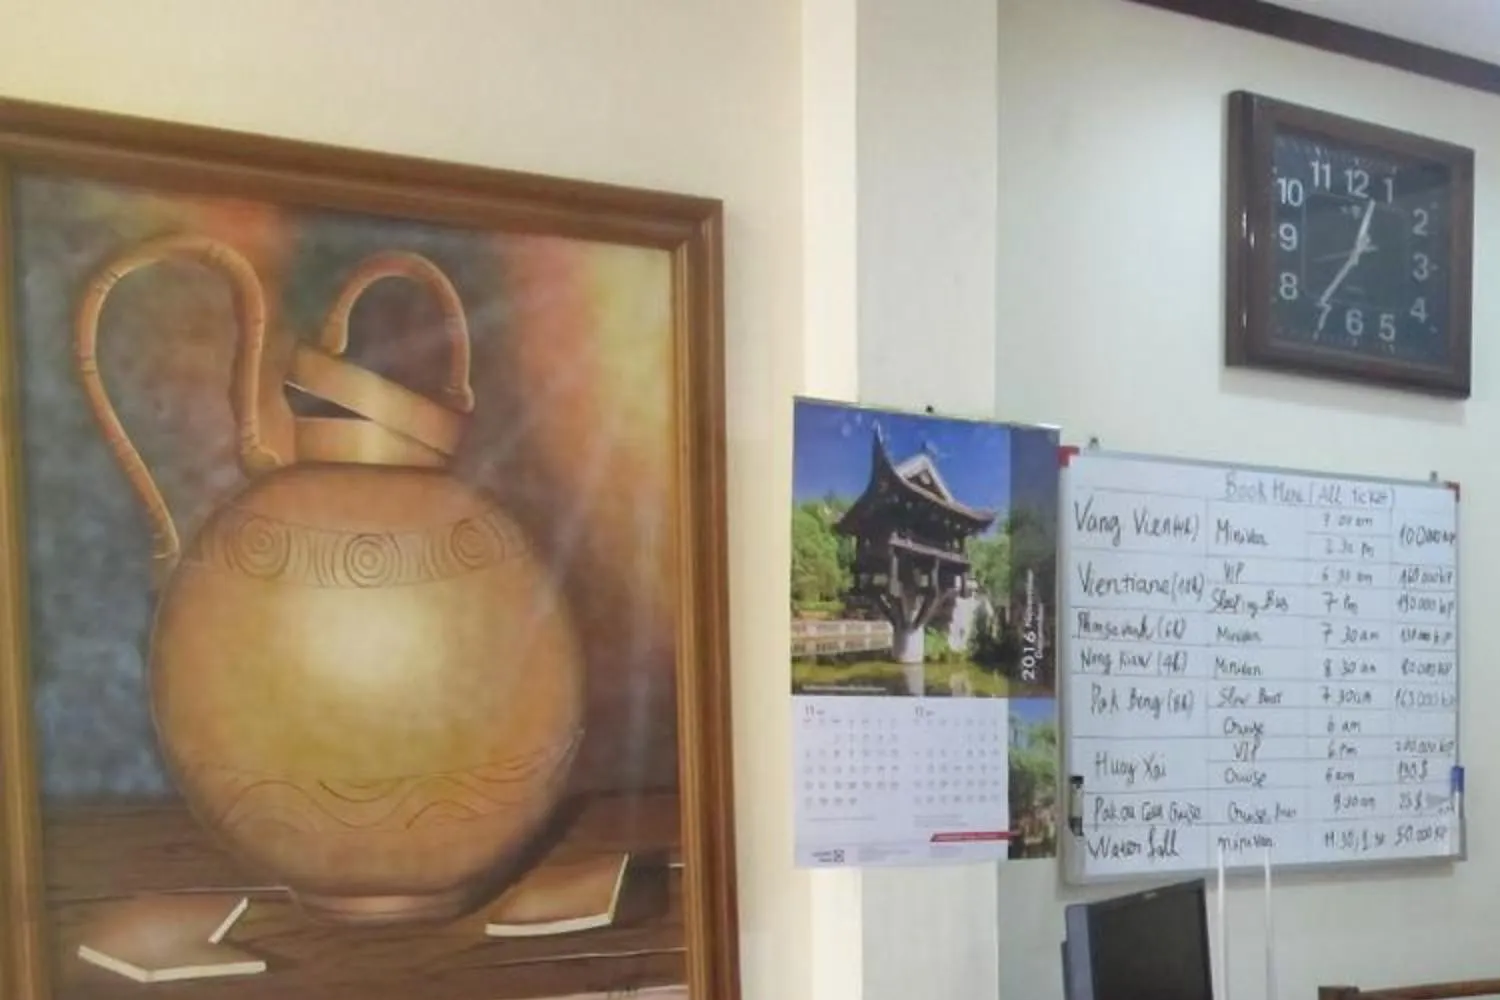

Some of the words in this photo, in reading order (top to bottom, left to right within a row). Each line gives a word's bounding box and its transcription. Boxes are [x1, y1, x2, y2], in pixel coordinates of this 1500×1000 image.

[1310, 160, 1331, 190] 11
[1344, 168, 1370, 199] 12
[1276, 176, 1303, 207] 10
[1383, 177, 1394, 204] 1
[1412, 208, 1428, 236] 2
[1279, 222, 1297, 251] 9
[1412, 253, 1429, 281] 3
[1279, 272, 1298, 300] 8
[1317, 300, 1332, 330] 7
[1345, 308, 1363, 336] 6
[1410, 297, 1428, 323] 4
[1379, 313, 1395, 341] 5
[1073, 496, 1122, 547] Vang
[1021, 631, 1037, 681] 2016
